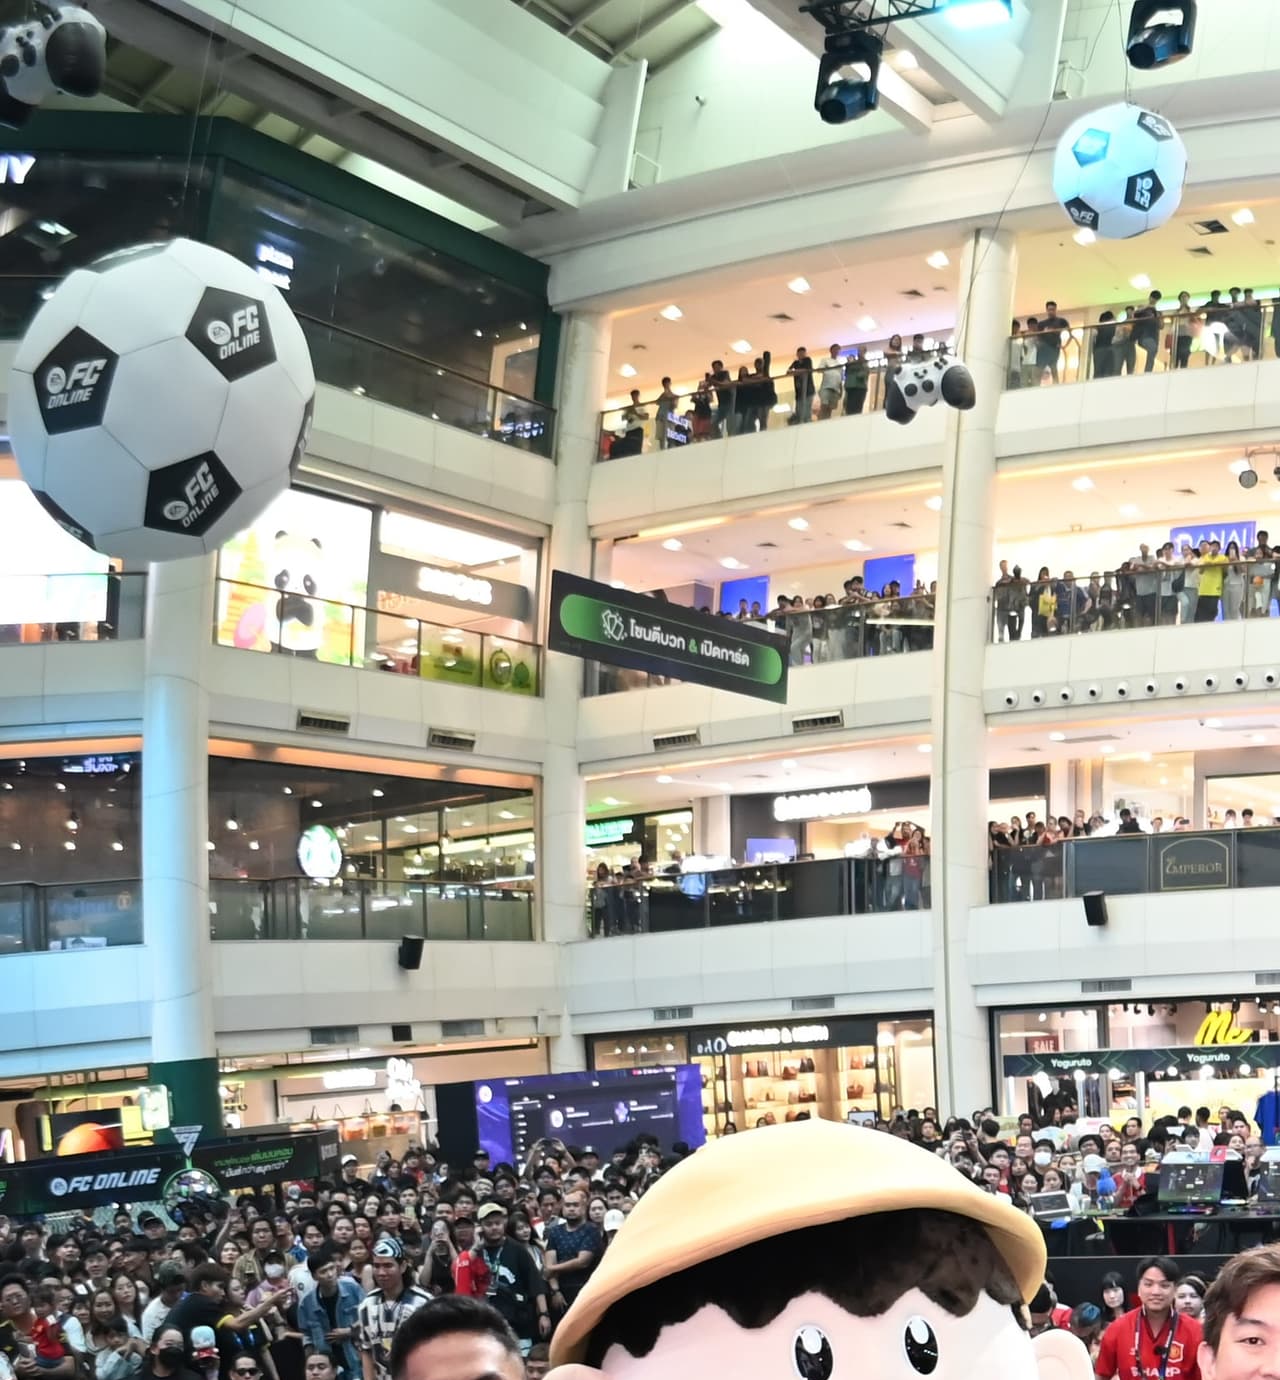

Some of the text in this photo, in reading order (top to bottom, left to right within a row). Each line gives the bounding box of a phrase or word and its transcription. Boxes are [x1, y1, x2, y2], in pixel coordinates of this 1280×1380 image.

[232, 305, 260, 338] FC
[219, 331, 261, 360] ONLINE
[65, 358, 108, 390] FC
[47, 387, 93, 409] ONLINE
[184, 461, 216, 506] FC
[182, 489, 220, 528] ONLINE
[688, 638, 698, 654] &
[1050, 1057, 1093, 1069] Yoguruto
[1186, 1053, 1230, 1064] Yoguruto
[68, 1168, 161, 1194] FC ONLINE
